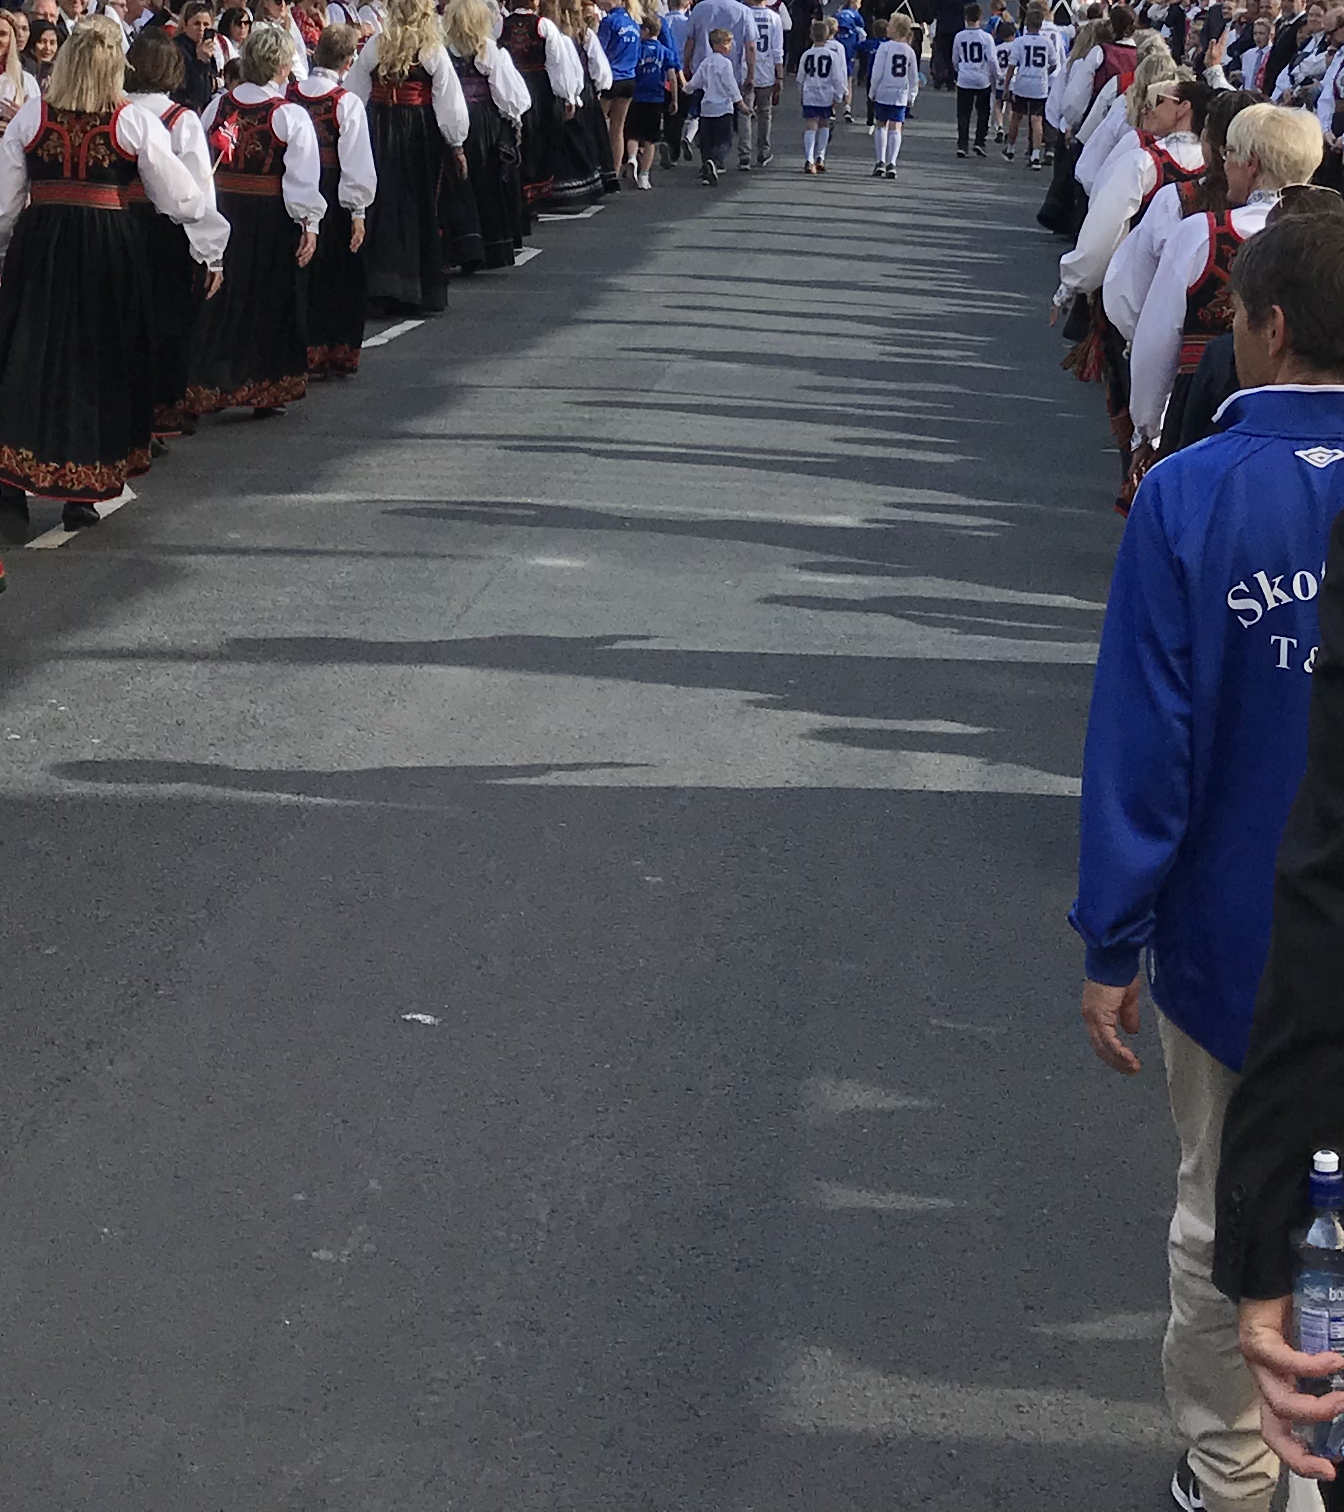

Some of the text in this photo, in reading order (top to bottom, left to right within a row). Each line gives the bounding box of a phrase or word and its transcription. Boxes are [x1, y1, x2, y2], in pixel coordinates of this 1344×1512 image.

[961, 41, 983, 63] 10
[1024, 45, 1046, 68] 15
[803, 54, 833, 78] 40
[891, 54, 907, 78] 8
[1270, 635, 1298, 670] T
